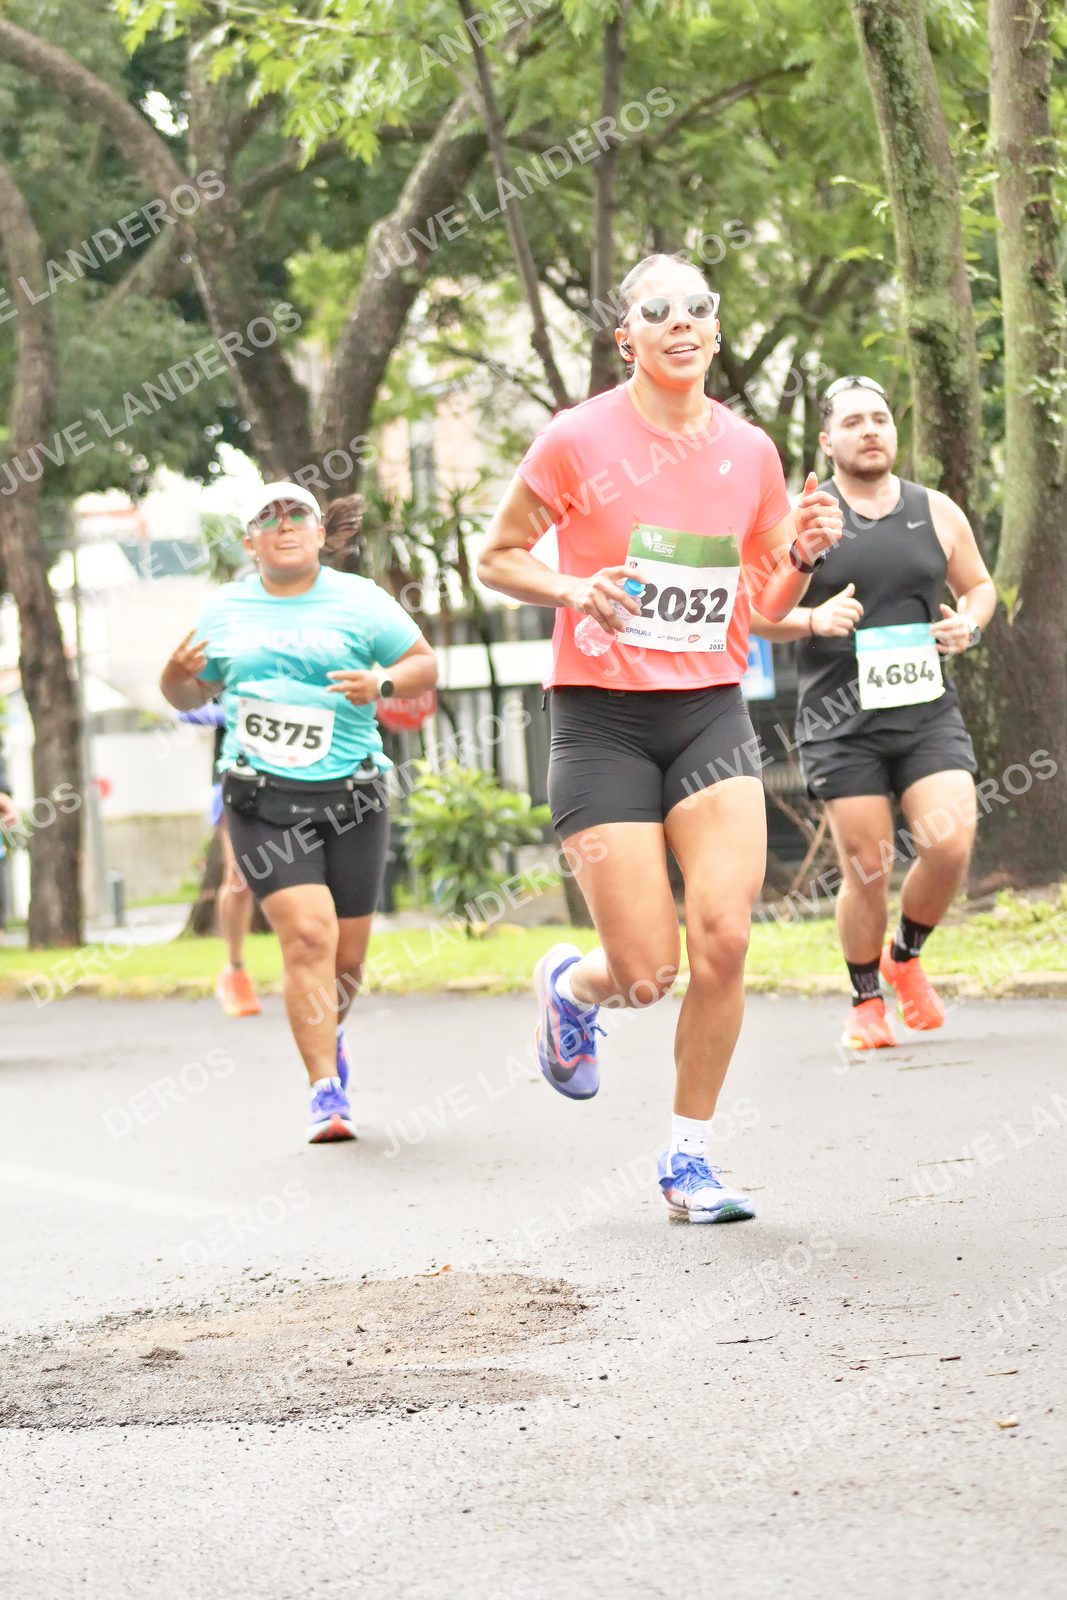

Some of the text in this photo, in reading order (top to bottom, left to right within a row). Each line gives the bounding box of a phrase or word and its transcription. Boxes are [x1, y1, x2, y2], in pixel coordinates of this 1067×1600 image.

[640, 583, 728, 623] 2032
[866, 660, 935, 688] 4684
[245, 713, 324, 750] 6375
